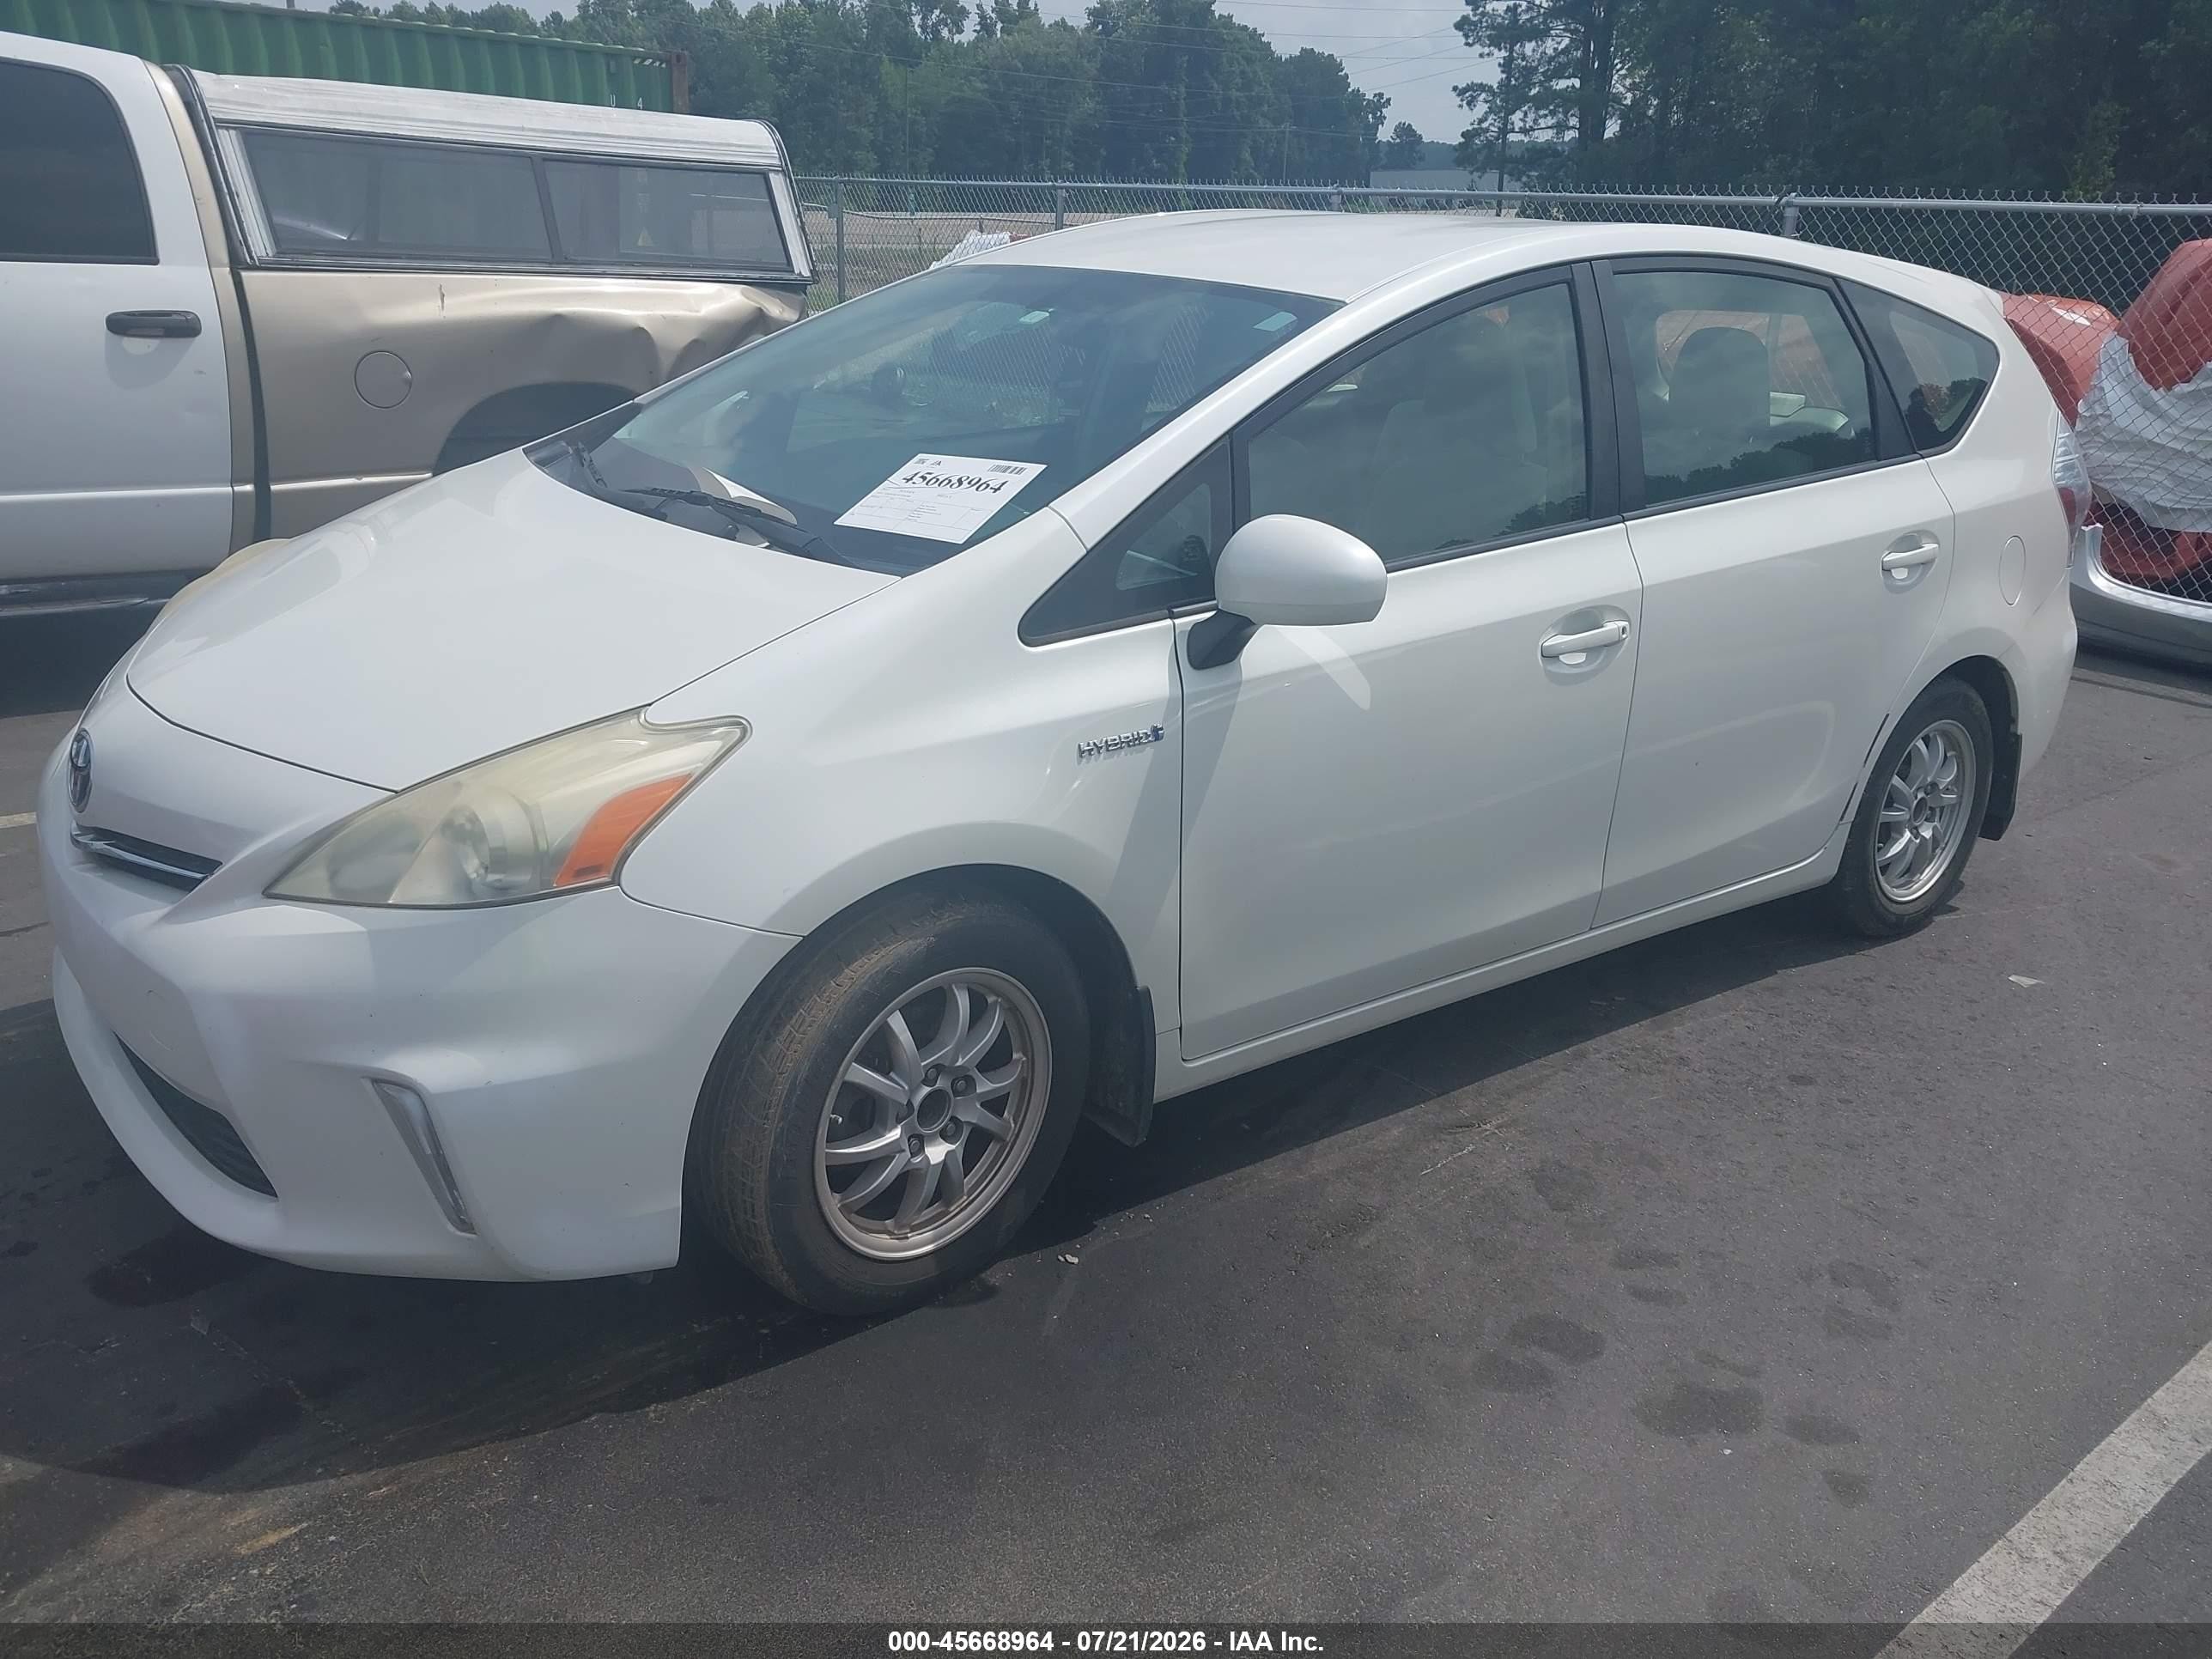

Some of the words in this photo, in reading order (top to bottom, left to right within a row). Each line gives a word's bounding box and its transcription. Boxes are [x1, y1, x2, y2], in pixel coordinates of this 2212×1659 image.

[637, 97, 643, 110] 4
[902, 471, 1008, 494] 45668964
[1078, 729, 1152, 758] HYBRID
